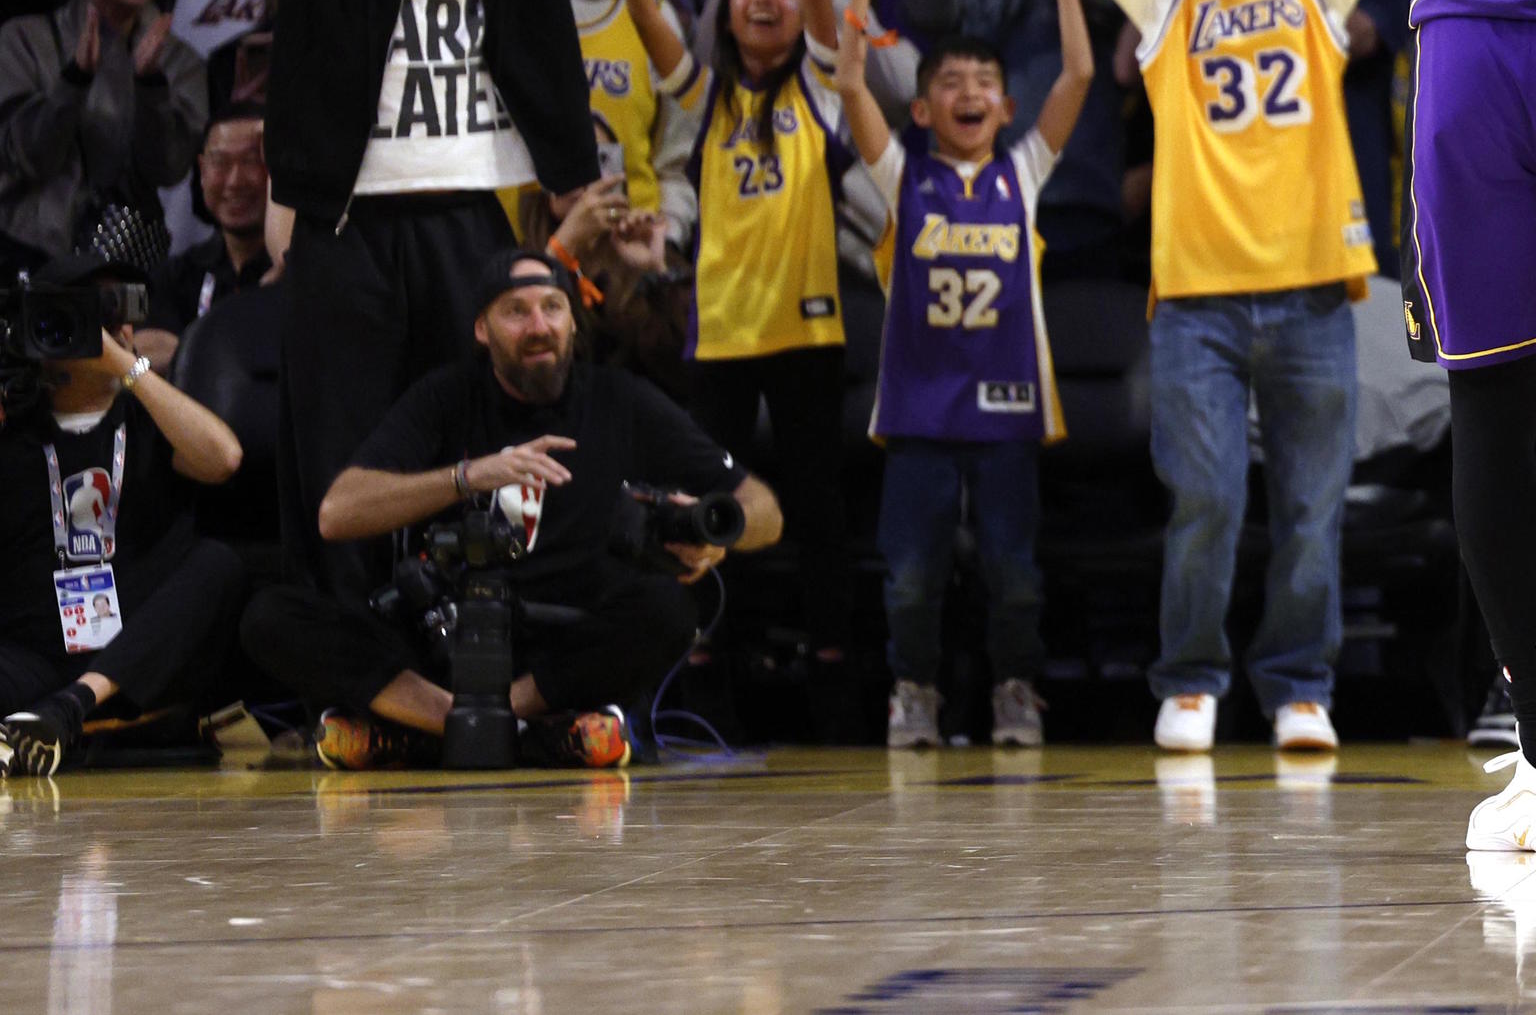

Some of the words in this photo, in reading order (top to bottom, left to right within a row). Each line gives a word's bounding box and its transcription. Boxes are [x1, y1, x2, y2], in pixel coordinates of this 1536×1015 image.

[1202, 49, 1311, 132] 32
[734, 154, 783, 197] 23
[912, 213, 1021, 264] LAKERS
[927, 267, 1002, 329] 32
